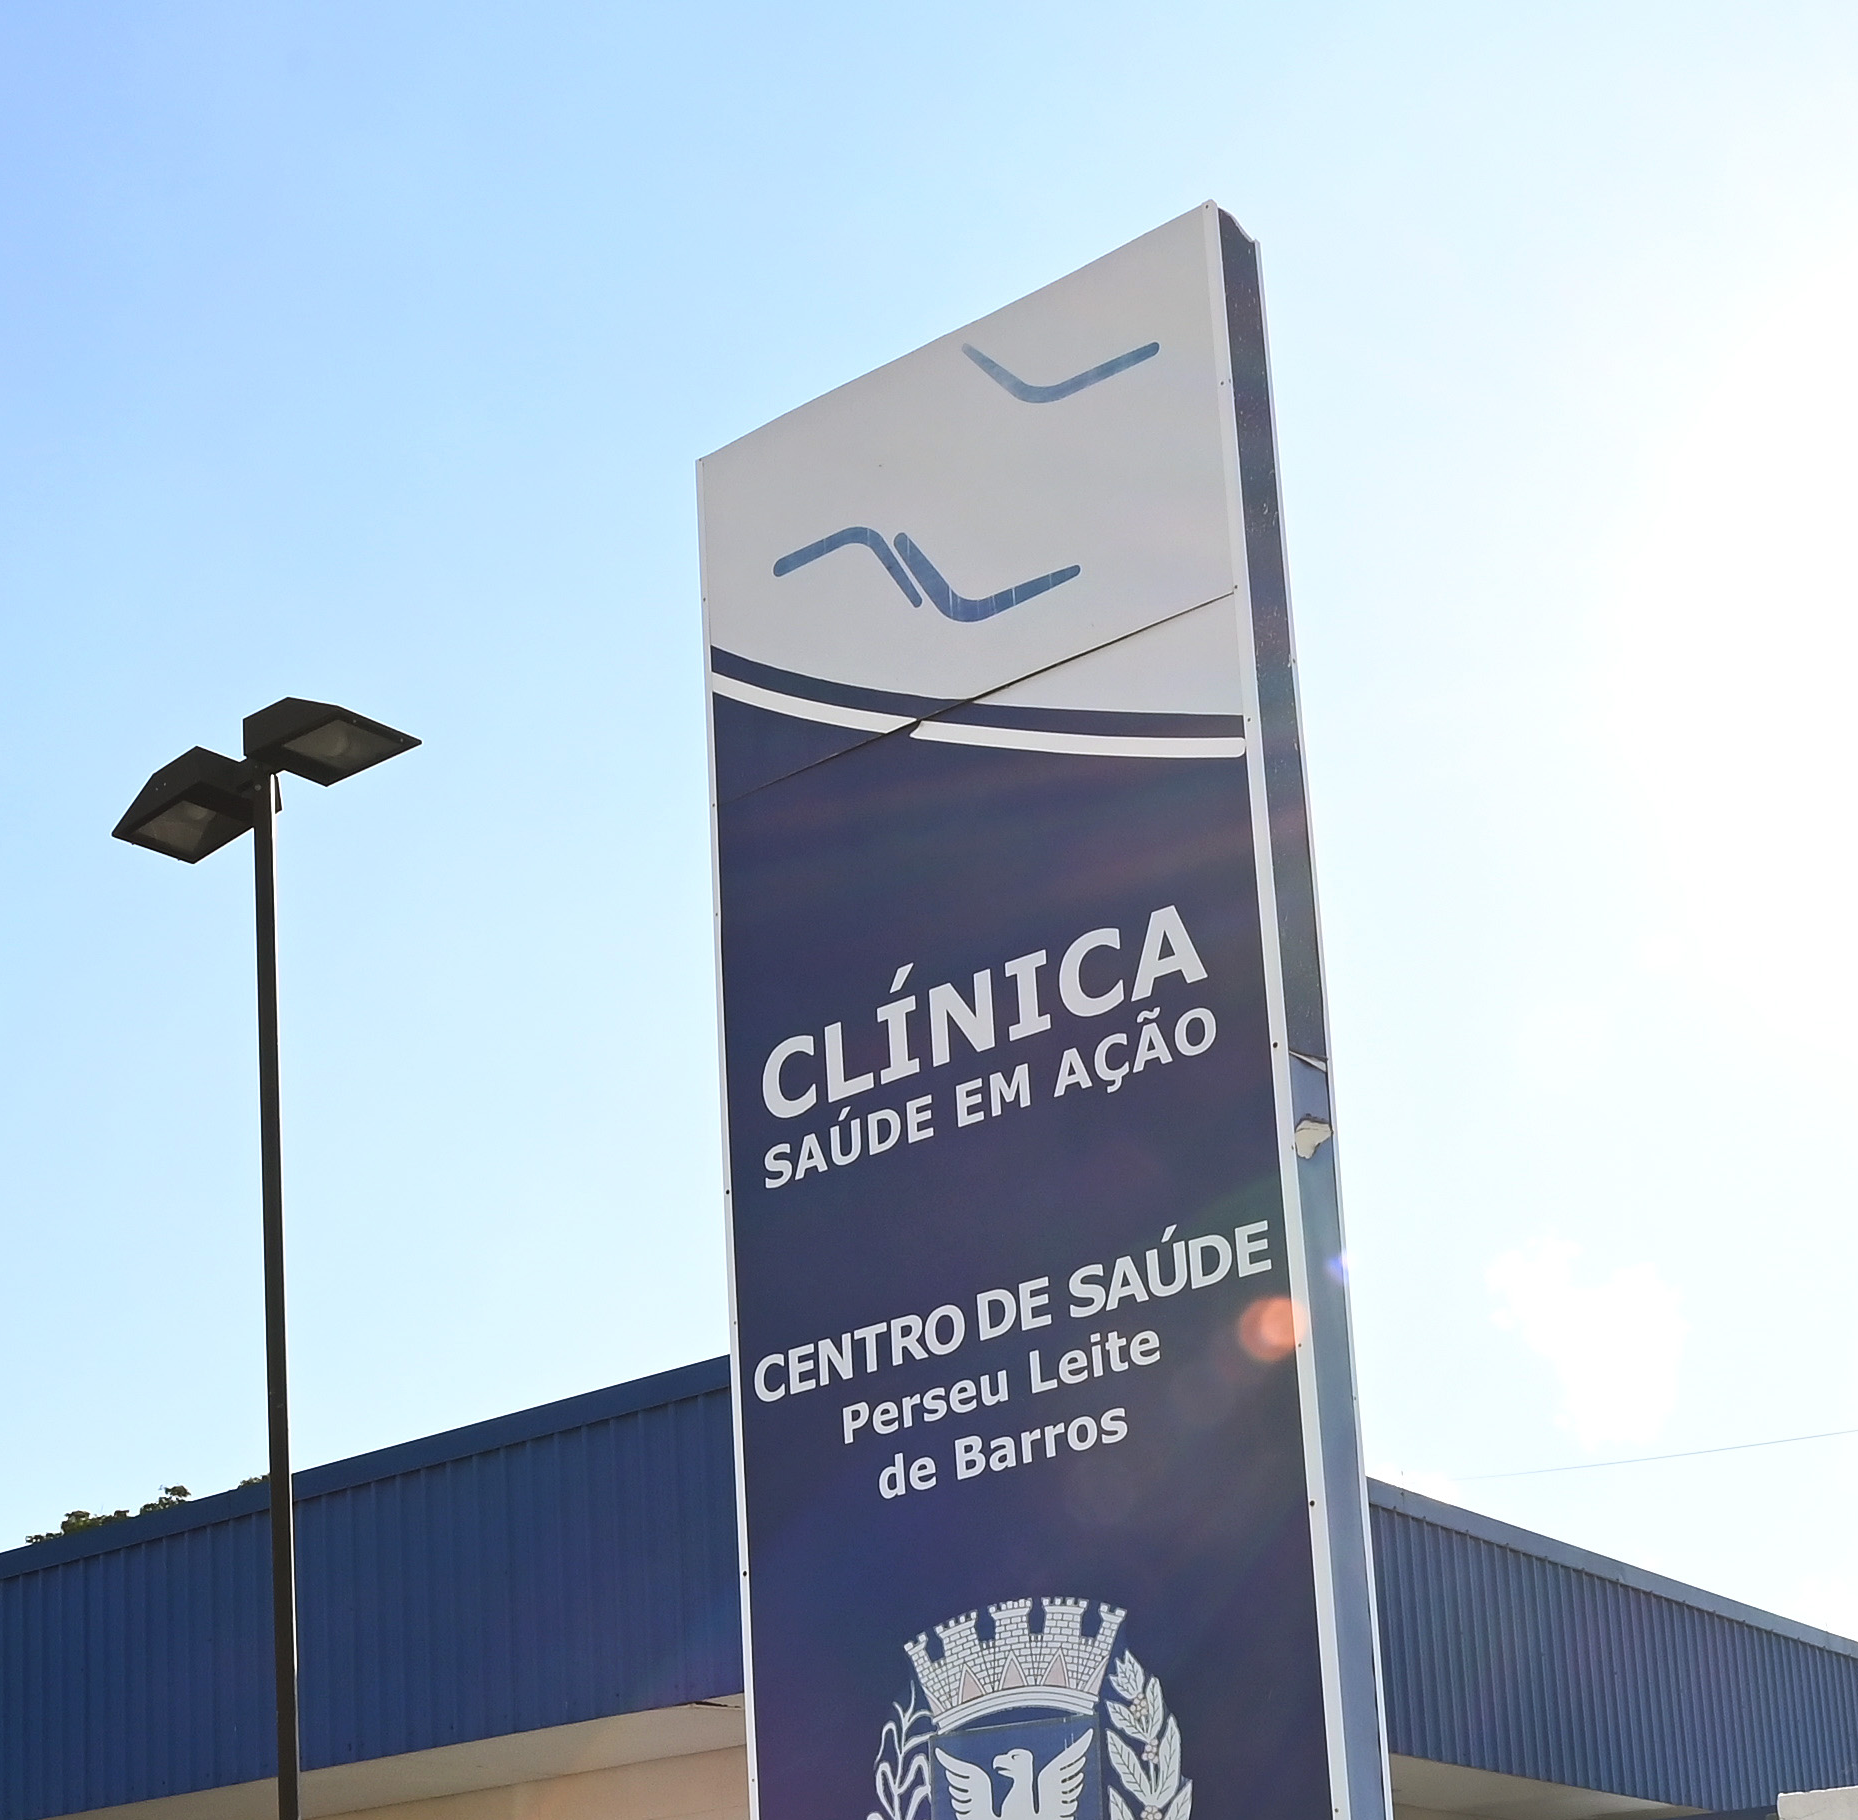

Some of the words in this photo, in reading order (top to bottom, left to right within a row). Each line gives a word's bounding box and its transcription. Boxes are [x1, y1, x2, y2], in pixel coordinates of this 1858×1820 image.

[761, 904, 1209, 1119] CLÍNICA
[764, 1094, 934, 1189] SAÚDE
[955, 1063, 1032, 1128] EM
[1053, 1006, 1217, 1098] AÇÃO
[753, 1303, 967, 1404] CENTRO
[976, 1276, 1052, 1341] DE
[1067, 1220, 1273, 1319] SAÚDE
[841, 1369, 1009, 1445] Perseu
[1029, 1330, 1162, 1394] Leite
[878, 1452, 937, 1499] de
[954, 1407, 1129, 1481] Barros
